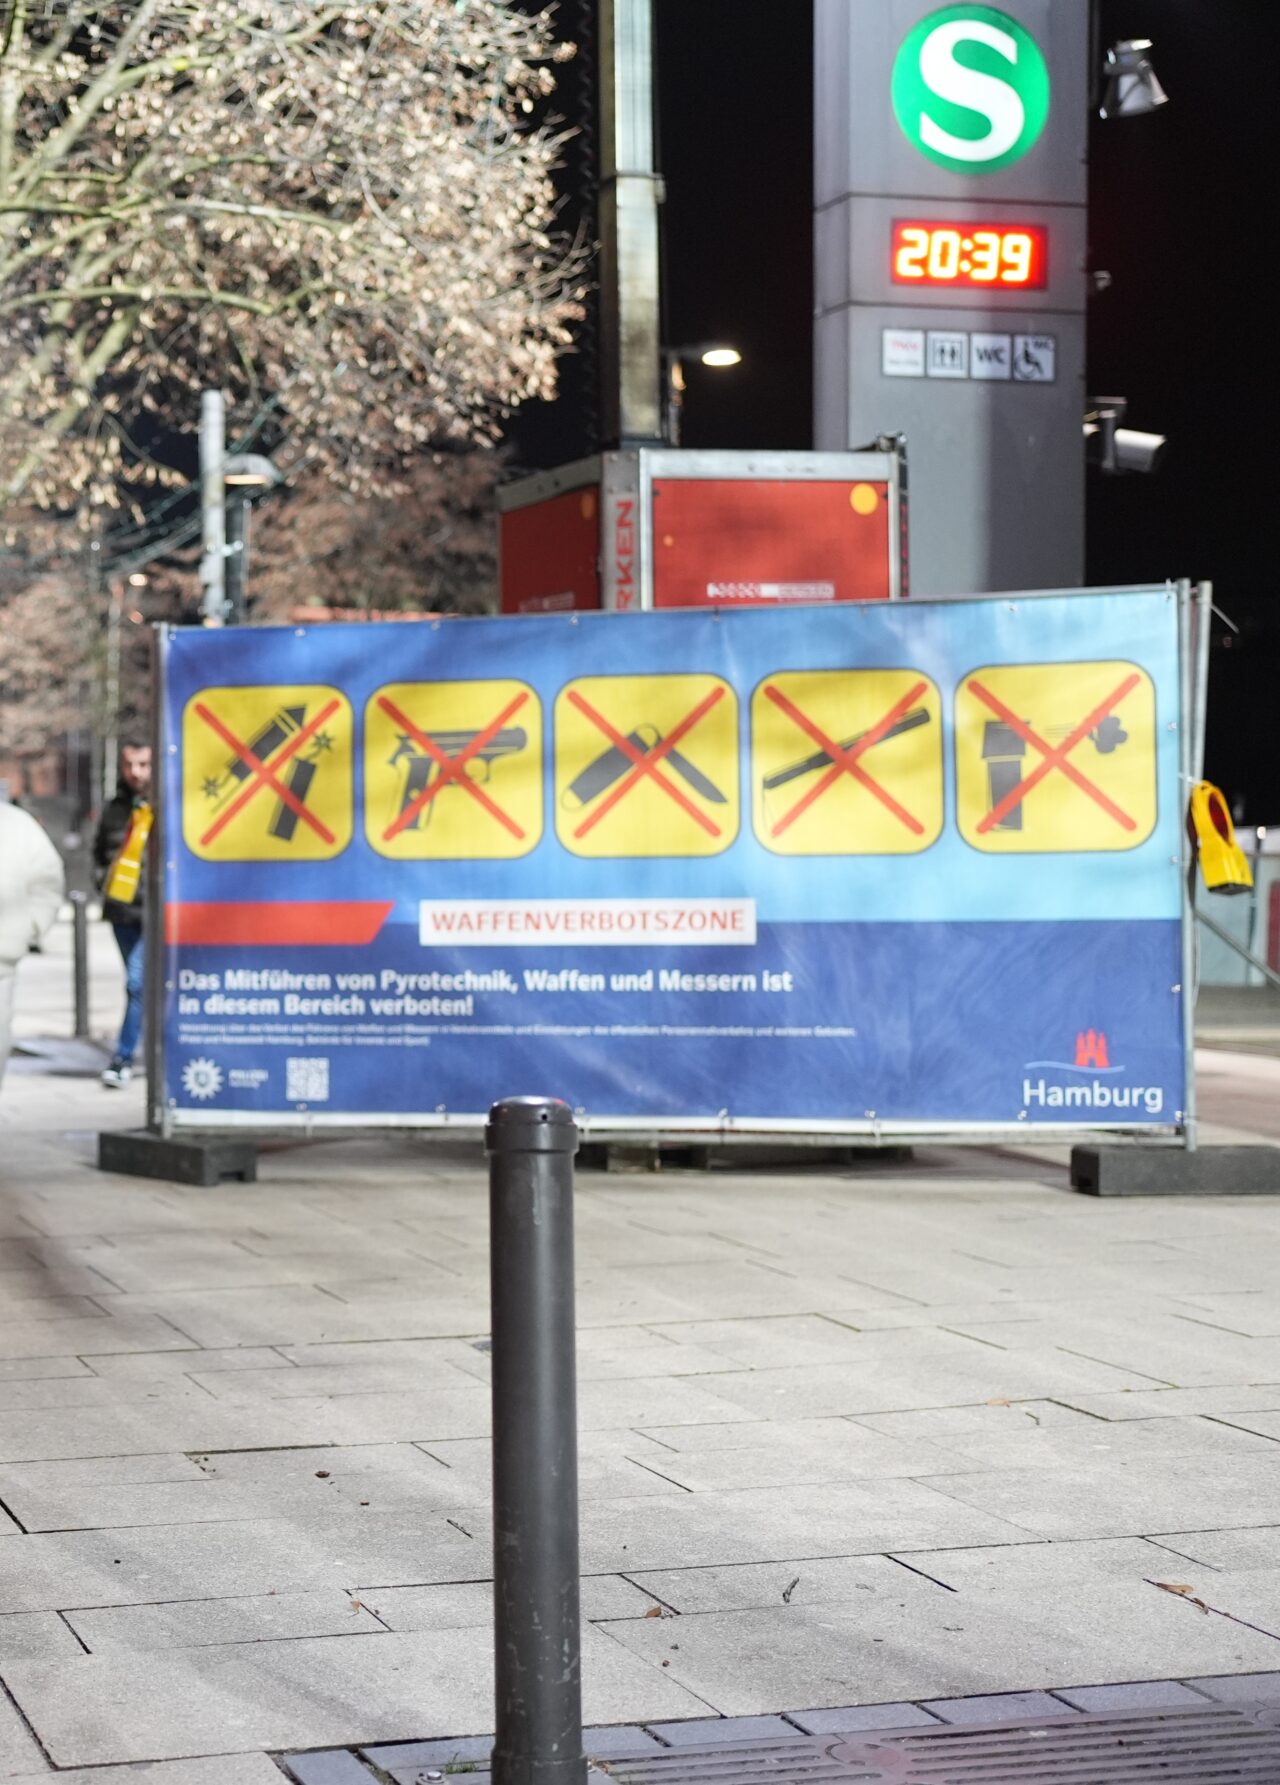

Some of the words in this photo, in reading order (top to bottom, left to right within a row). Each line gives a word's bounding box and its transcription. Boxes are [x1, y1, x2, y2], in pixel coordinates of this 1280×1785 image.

[920, 19, 1025, 162] S
[896, 228, 1032, 283] 20:39
[976, 346, 1005, 366] WC
[431, 909, 745, 932] WAFFENVERBOTSZONE
[179, 970, 219, 990] Das
[225, 969, 331, 991] Mitführen
[336, 974, 375, 990] von
[381, 969, 519, 994] Pyrotechnik,
[524, 970, 605, 991] Waffen
[610, 970, 654, 991] und
[659, 970, 756, 992] Messern
[762, 970, 794, 992] ist
[179, 995, 199, 1015] in
[204, 994, 280, 1015] diesem
[284, 994, 365, 1016] Bereich
[370, 995, 474, 1016] verboten!
[1023, 1079, 1163, 1114] Hamburg
